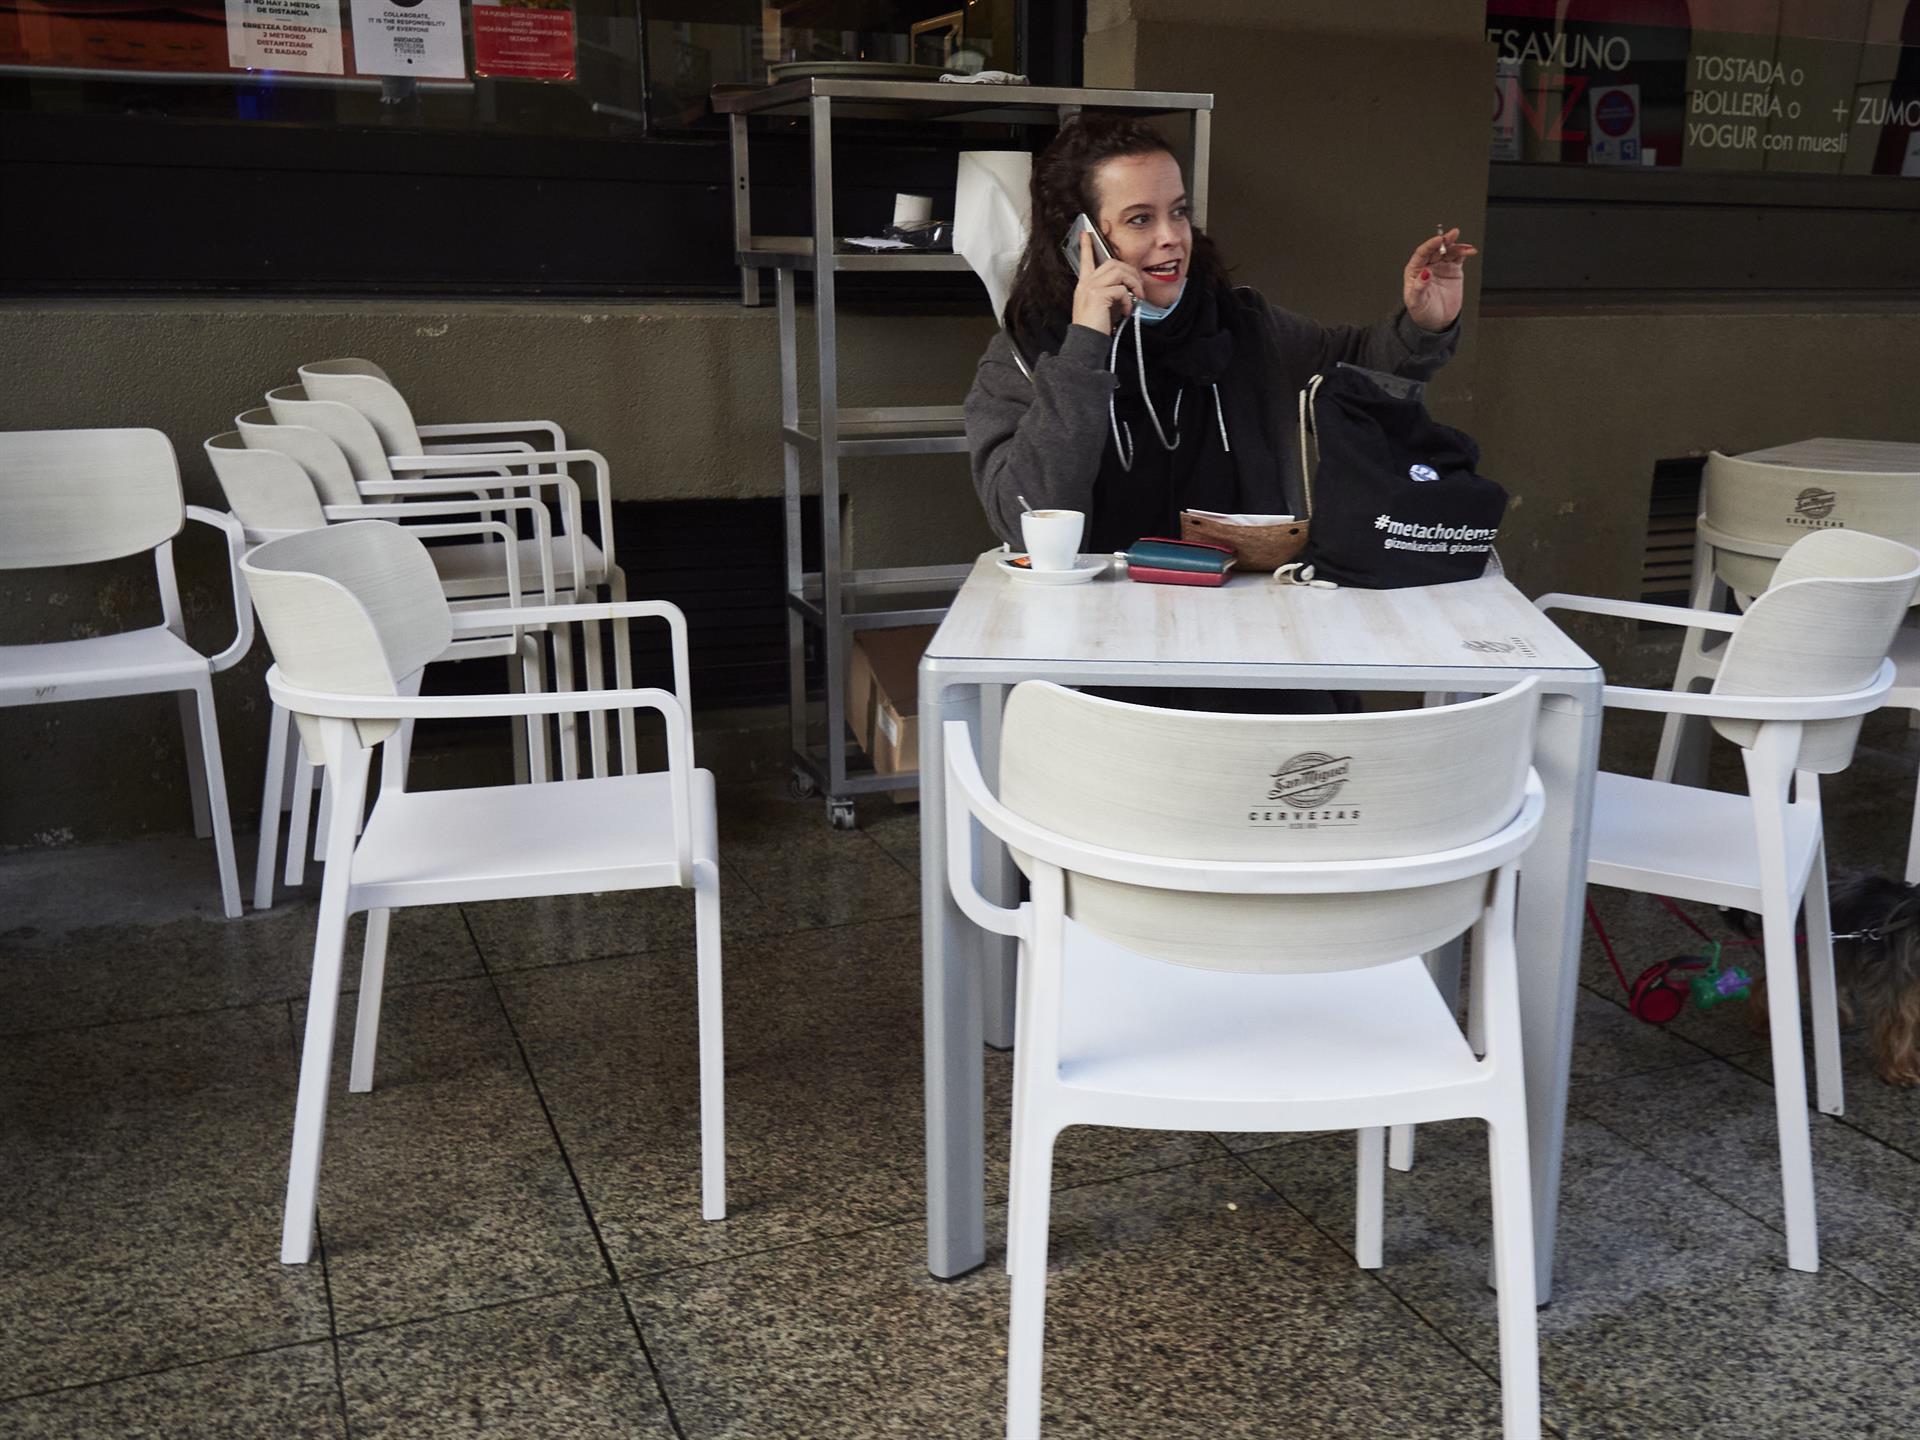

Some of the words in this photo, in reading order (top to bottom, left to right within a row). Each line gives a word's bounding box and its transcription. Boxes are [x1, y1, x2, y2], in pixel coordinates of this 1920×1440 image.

[269, 8, 309, 16] DISTANCIA
[396, 19, 446, 27] RESPONSIBILITY
[282, 25, 328, 34] DEBEKATUA
[1695, 55, 1786, 84] TOSTADA
[1790, 68, 1804, 86] o
[1691, 86, 1783, 119] BOLLERÍA
[1787, 101, 1801, 119] o
[1856, 97, 1920, 127] ZUMO
[1688, 122, 1757, 149] YOGUR
[1762, 133, 1793, 151] con
[1797, 133, 1848, 153] muesli
[1786, 517, 1844, 528] CERVEZAS
[1248, 810, 1361, 821] CERVEZAS
